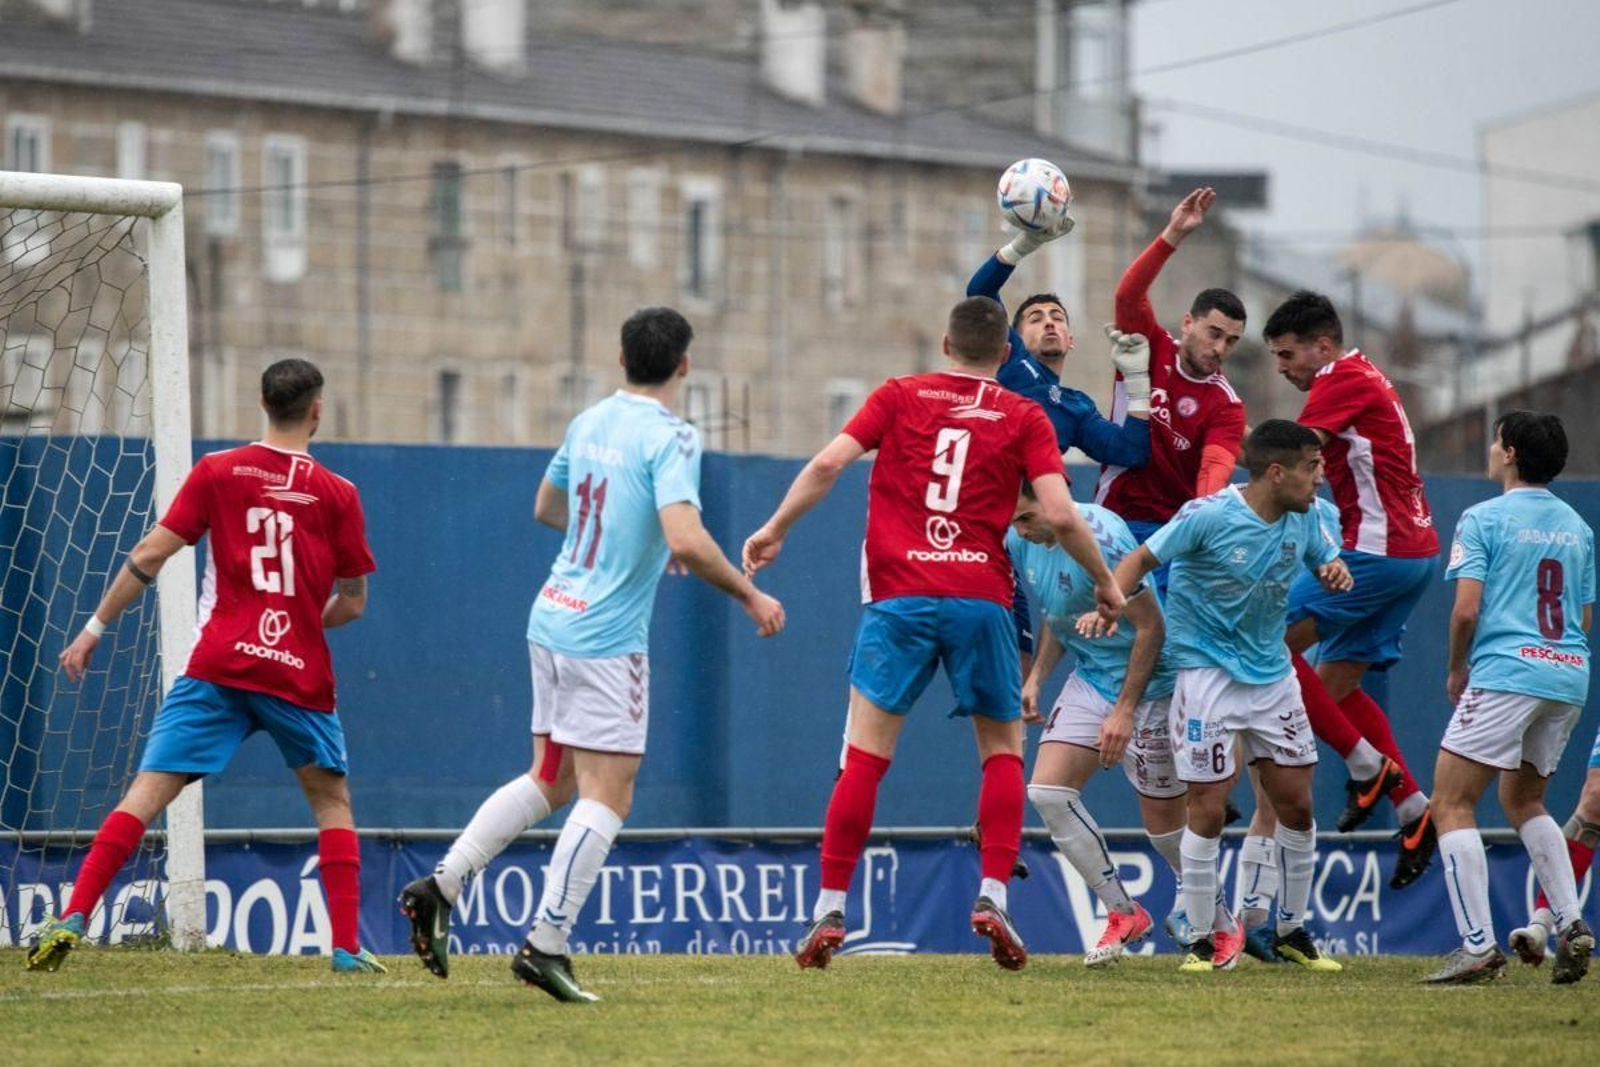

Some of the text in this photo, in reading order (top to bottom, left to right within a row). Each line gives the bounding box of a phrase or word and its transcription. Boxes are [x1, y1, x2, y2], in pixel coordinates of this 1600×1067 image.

[925, 428, 971, 513] 9
[246, 507, 296, 597] 21
[570, 472, 608, 569] 11
[907, 548, 988, 563] roombo
[1537, 558, 1565, 640] 8
[234, 641, 305, 671] roombo
[1212, 742, 1226, 774] 6
[449, 862, 809, 926] MOTERREI
